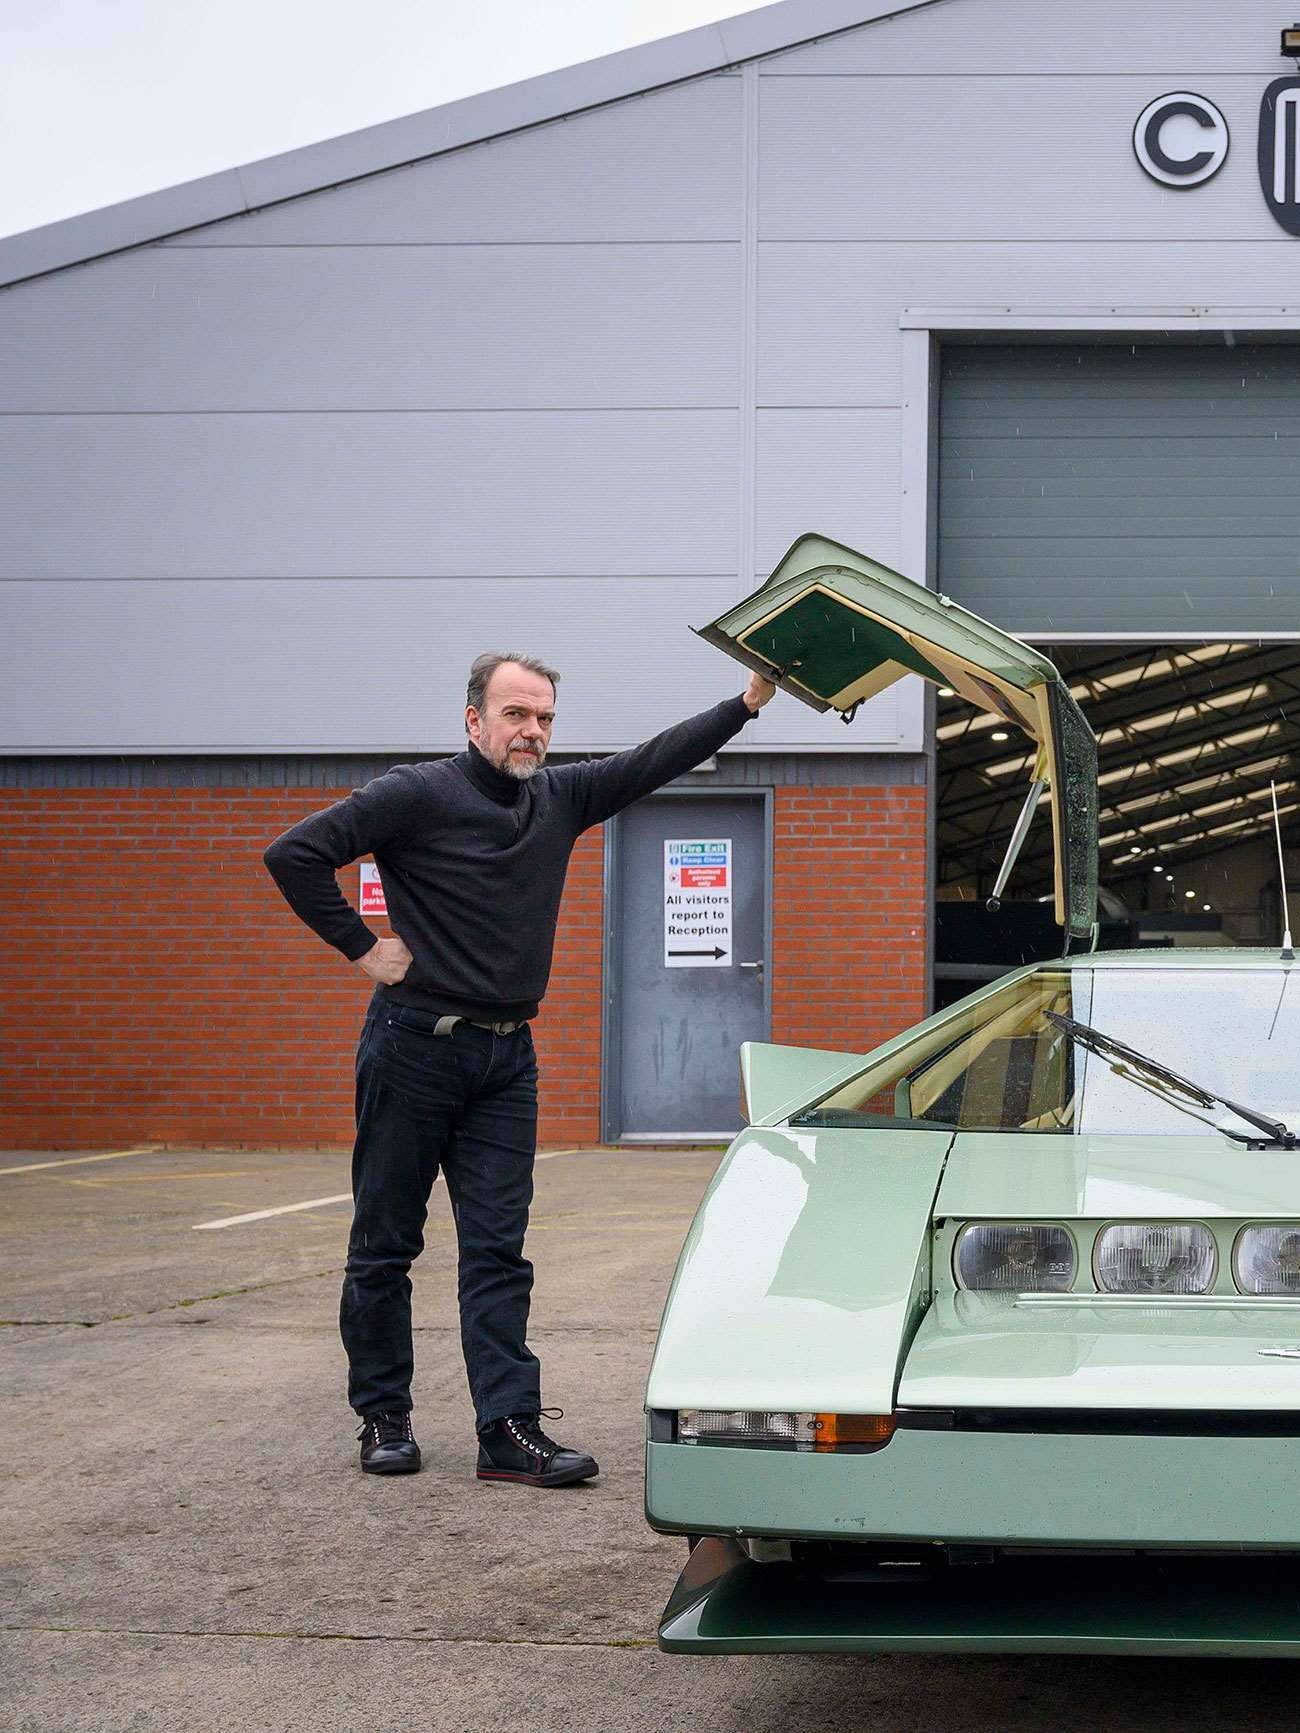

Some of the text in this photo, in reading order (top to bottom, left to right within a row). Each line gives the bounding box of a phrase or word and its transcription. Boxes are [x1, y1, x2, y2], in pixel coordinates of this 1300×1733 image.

[682, 844, 724, 853] Fire Exit
[372, 888, 383, 896] No
[666, 895, 729, 904] All visitors
[671, 911, 725, 922] report to
[668, 925, 728, 937] Reception
